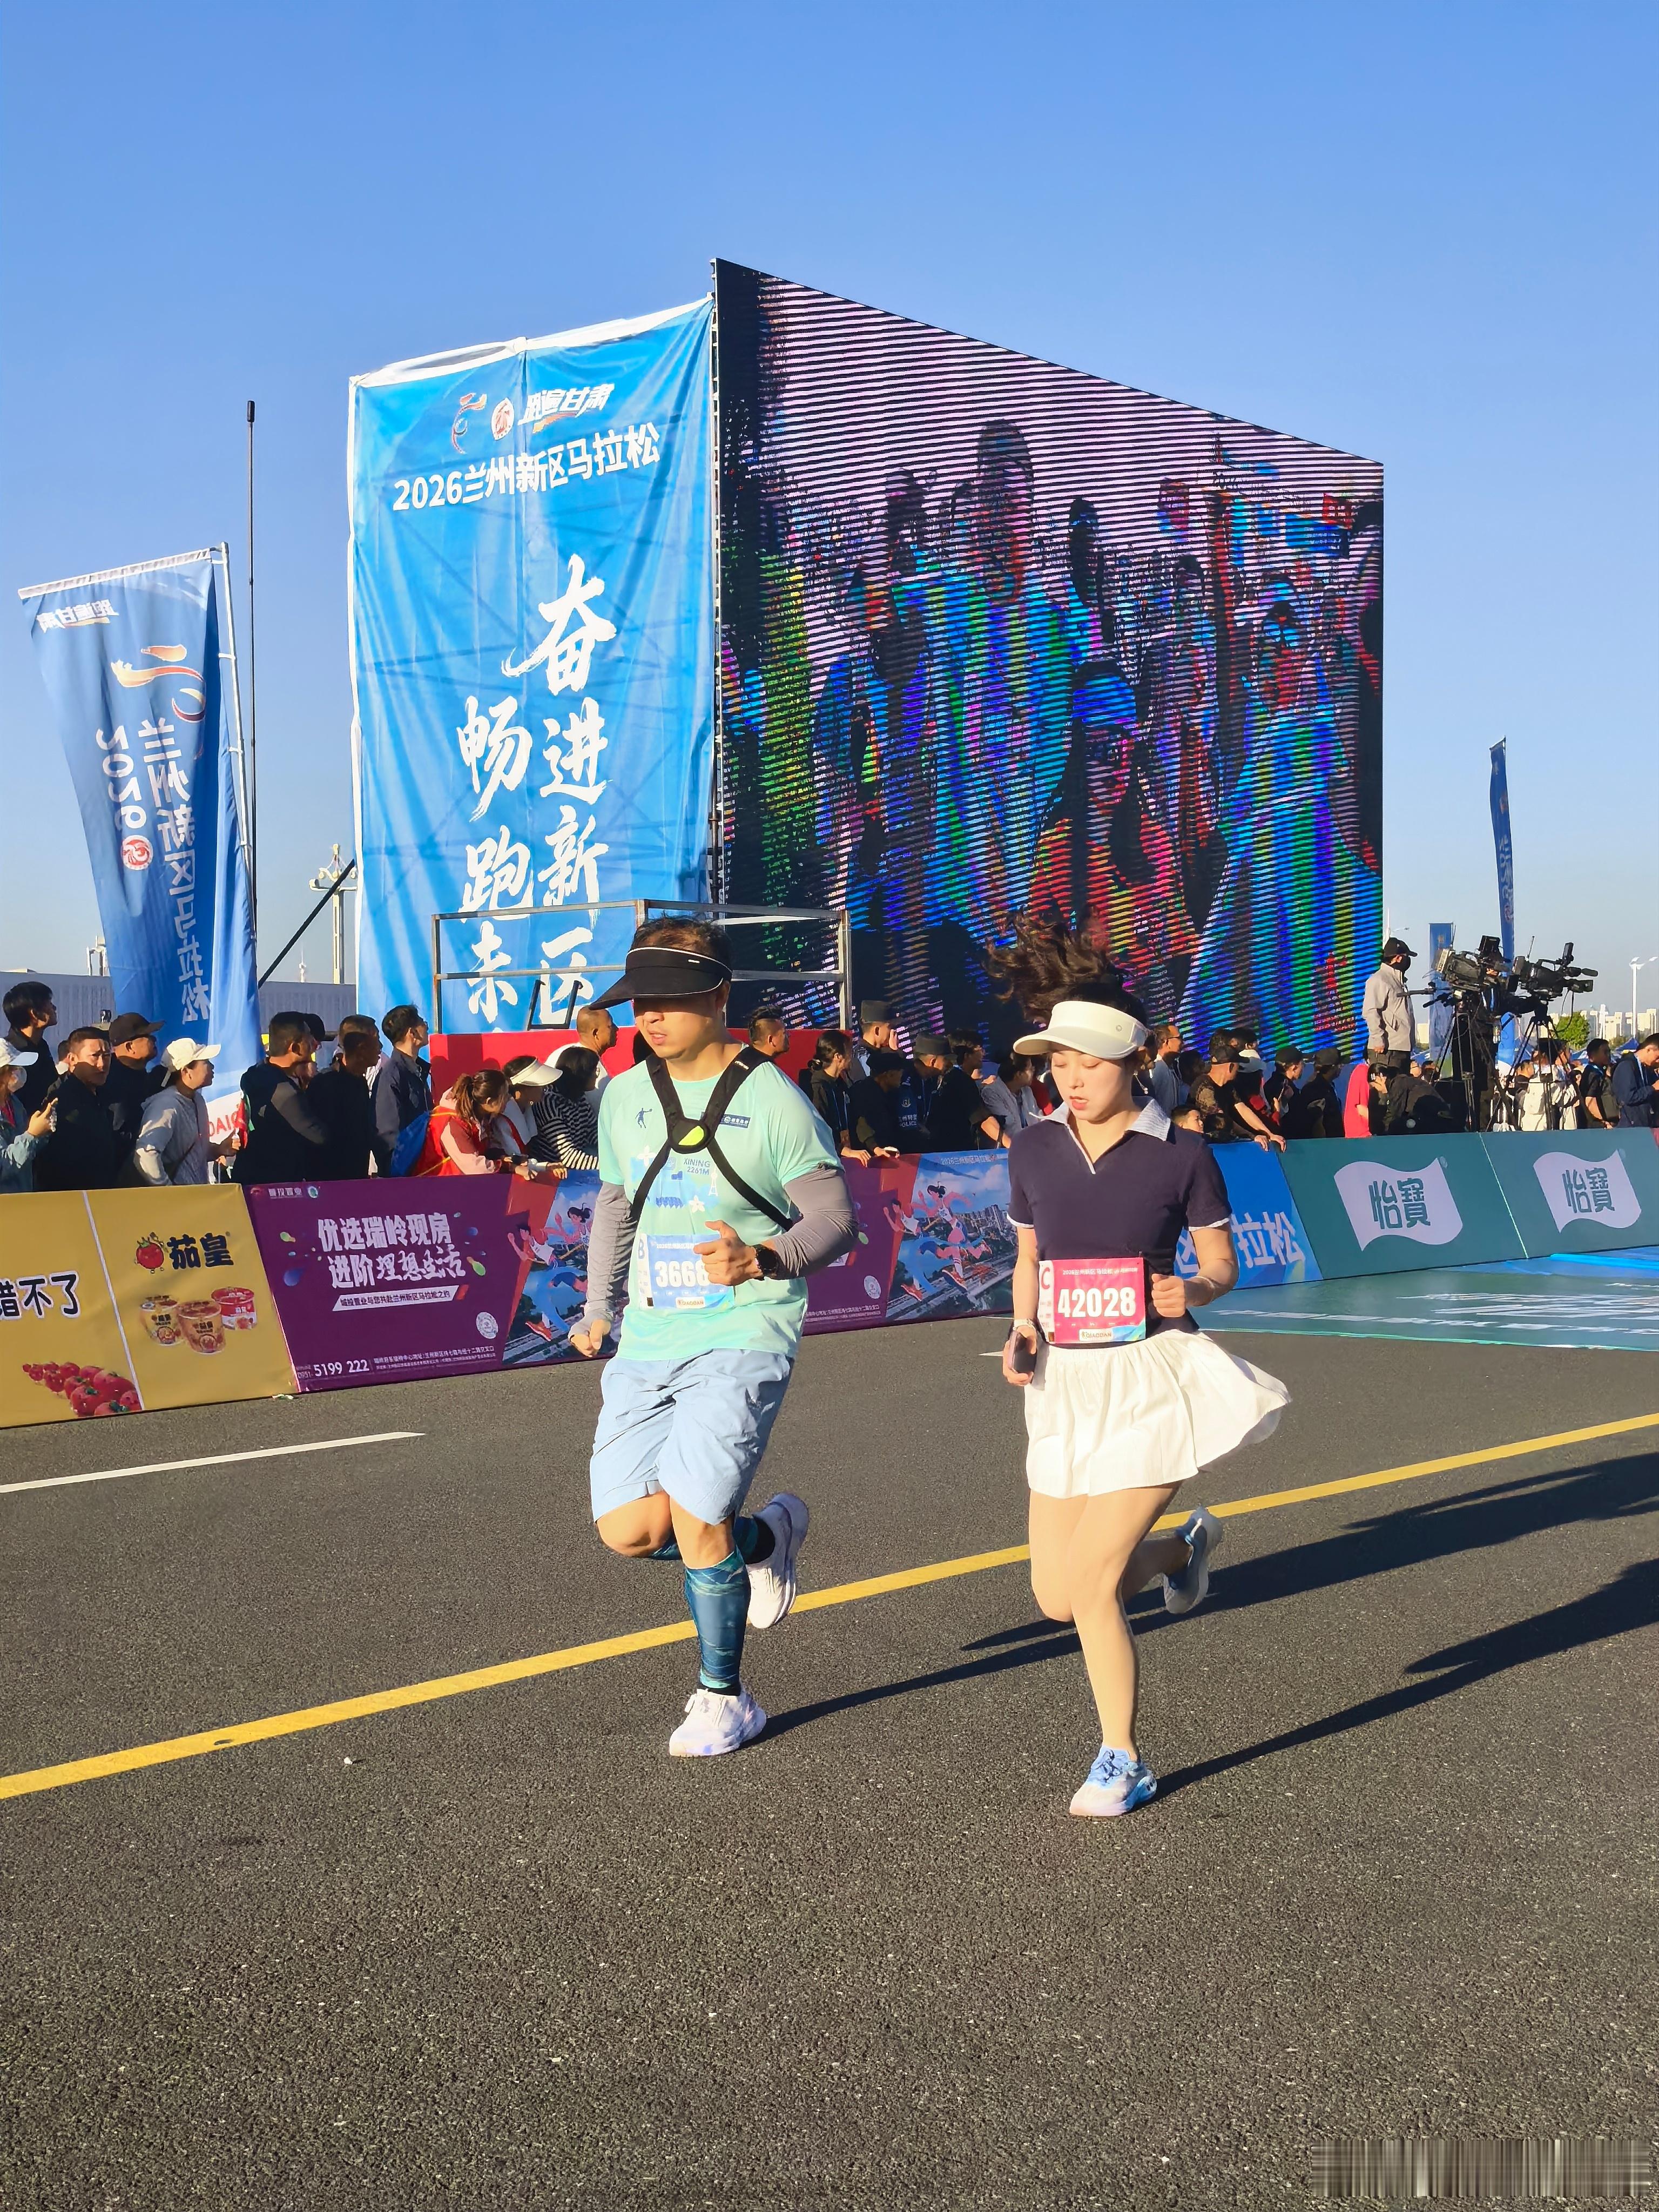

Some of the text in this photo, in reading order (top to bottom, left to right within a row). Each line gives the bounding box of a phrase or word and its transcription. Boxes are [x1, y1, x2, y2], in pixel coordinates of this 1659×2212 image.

[393, 423, 659, 511] 2026兰州新区马拉松
[456, 695, 532, 1033] 畅跑未
[684, 1158, 710, 1168] XINING
[687, 1166, 710, 1175] 2261M
[1368, 1178, 1431, 1230] 怡寶
[1562, 1168, 1615, 1213] 怡寶
[167, 1232, 234, 1270] 茄皇
[318, 1212, 451, 1252] 优选瑞岭现房
[1041, 1267, 1050, 1289] C
[1058, 1287, 1136, 1318] 42028
[314, 1362, 342, 1377] 5199
[347, 1359, 369, 1373] 222
